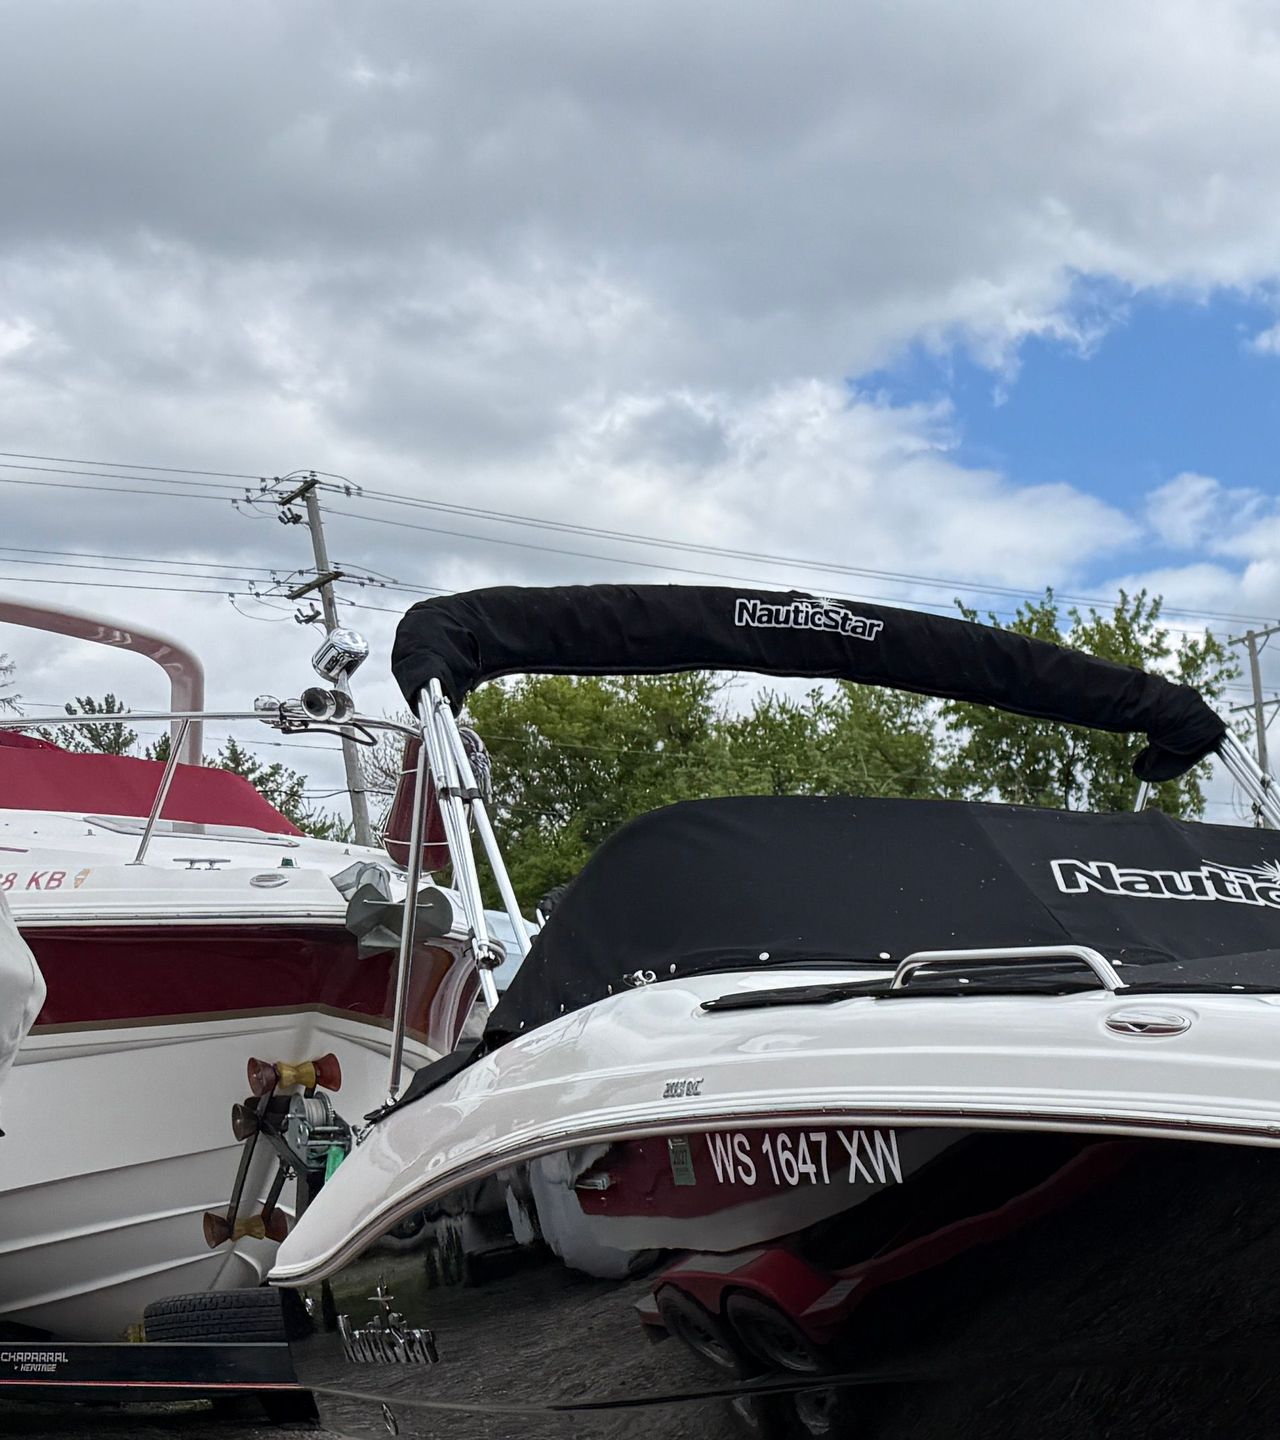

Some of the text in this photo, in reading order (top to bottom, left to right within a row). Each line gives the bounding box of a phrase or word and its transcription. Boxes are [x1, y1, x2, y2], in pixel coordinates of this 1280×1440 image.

[735, 599, 883, 641] NauticStar
[25, 871, 67, 891] KB
[706, 1129, 904, 1186] WS 1647 XW
[0, 1352, 69, 1362] CHAPARRAL
